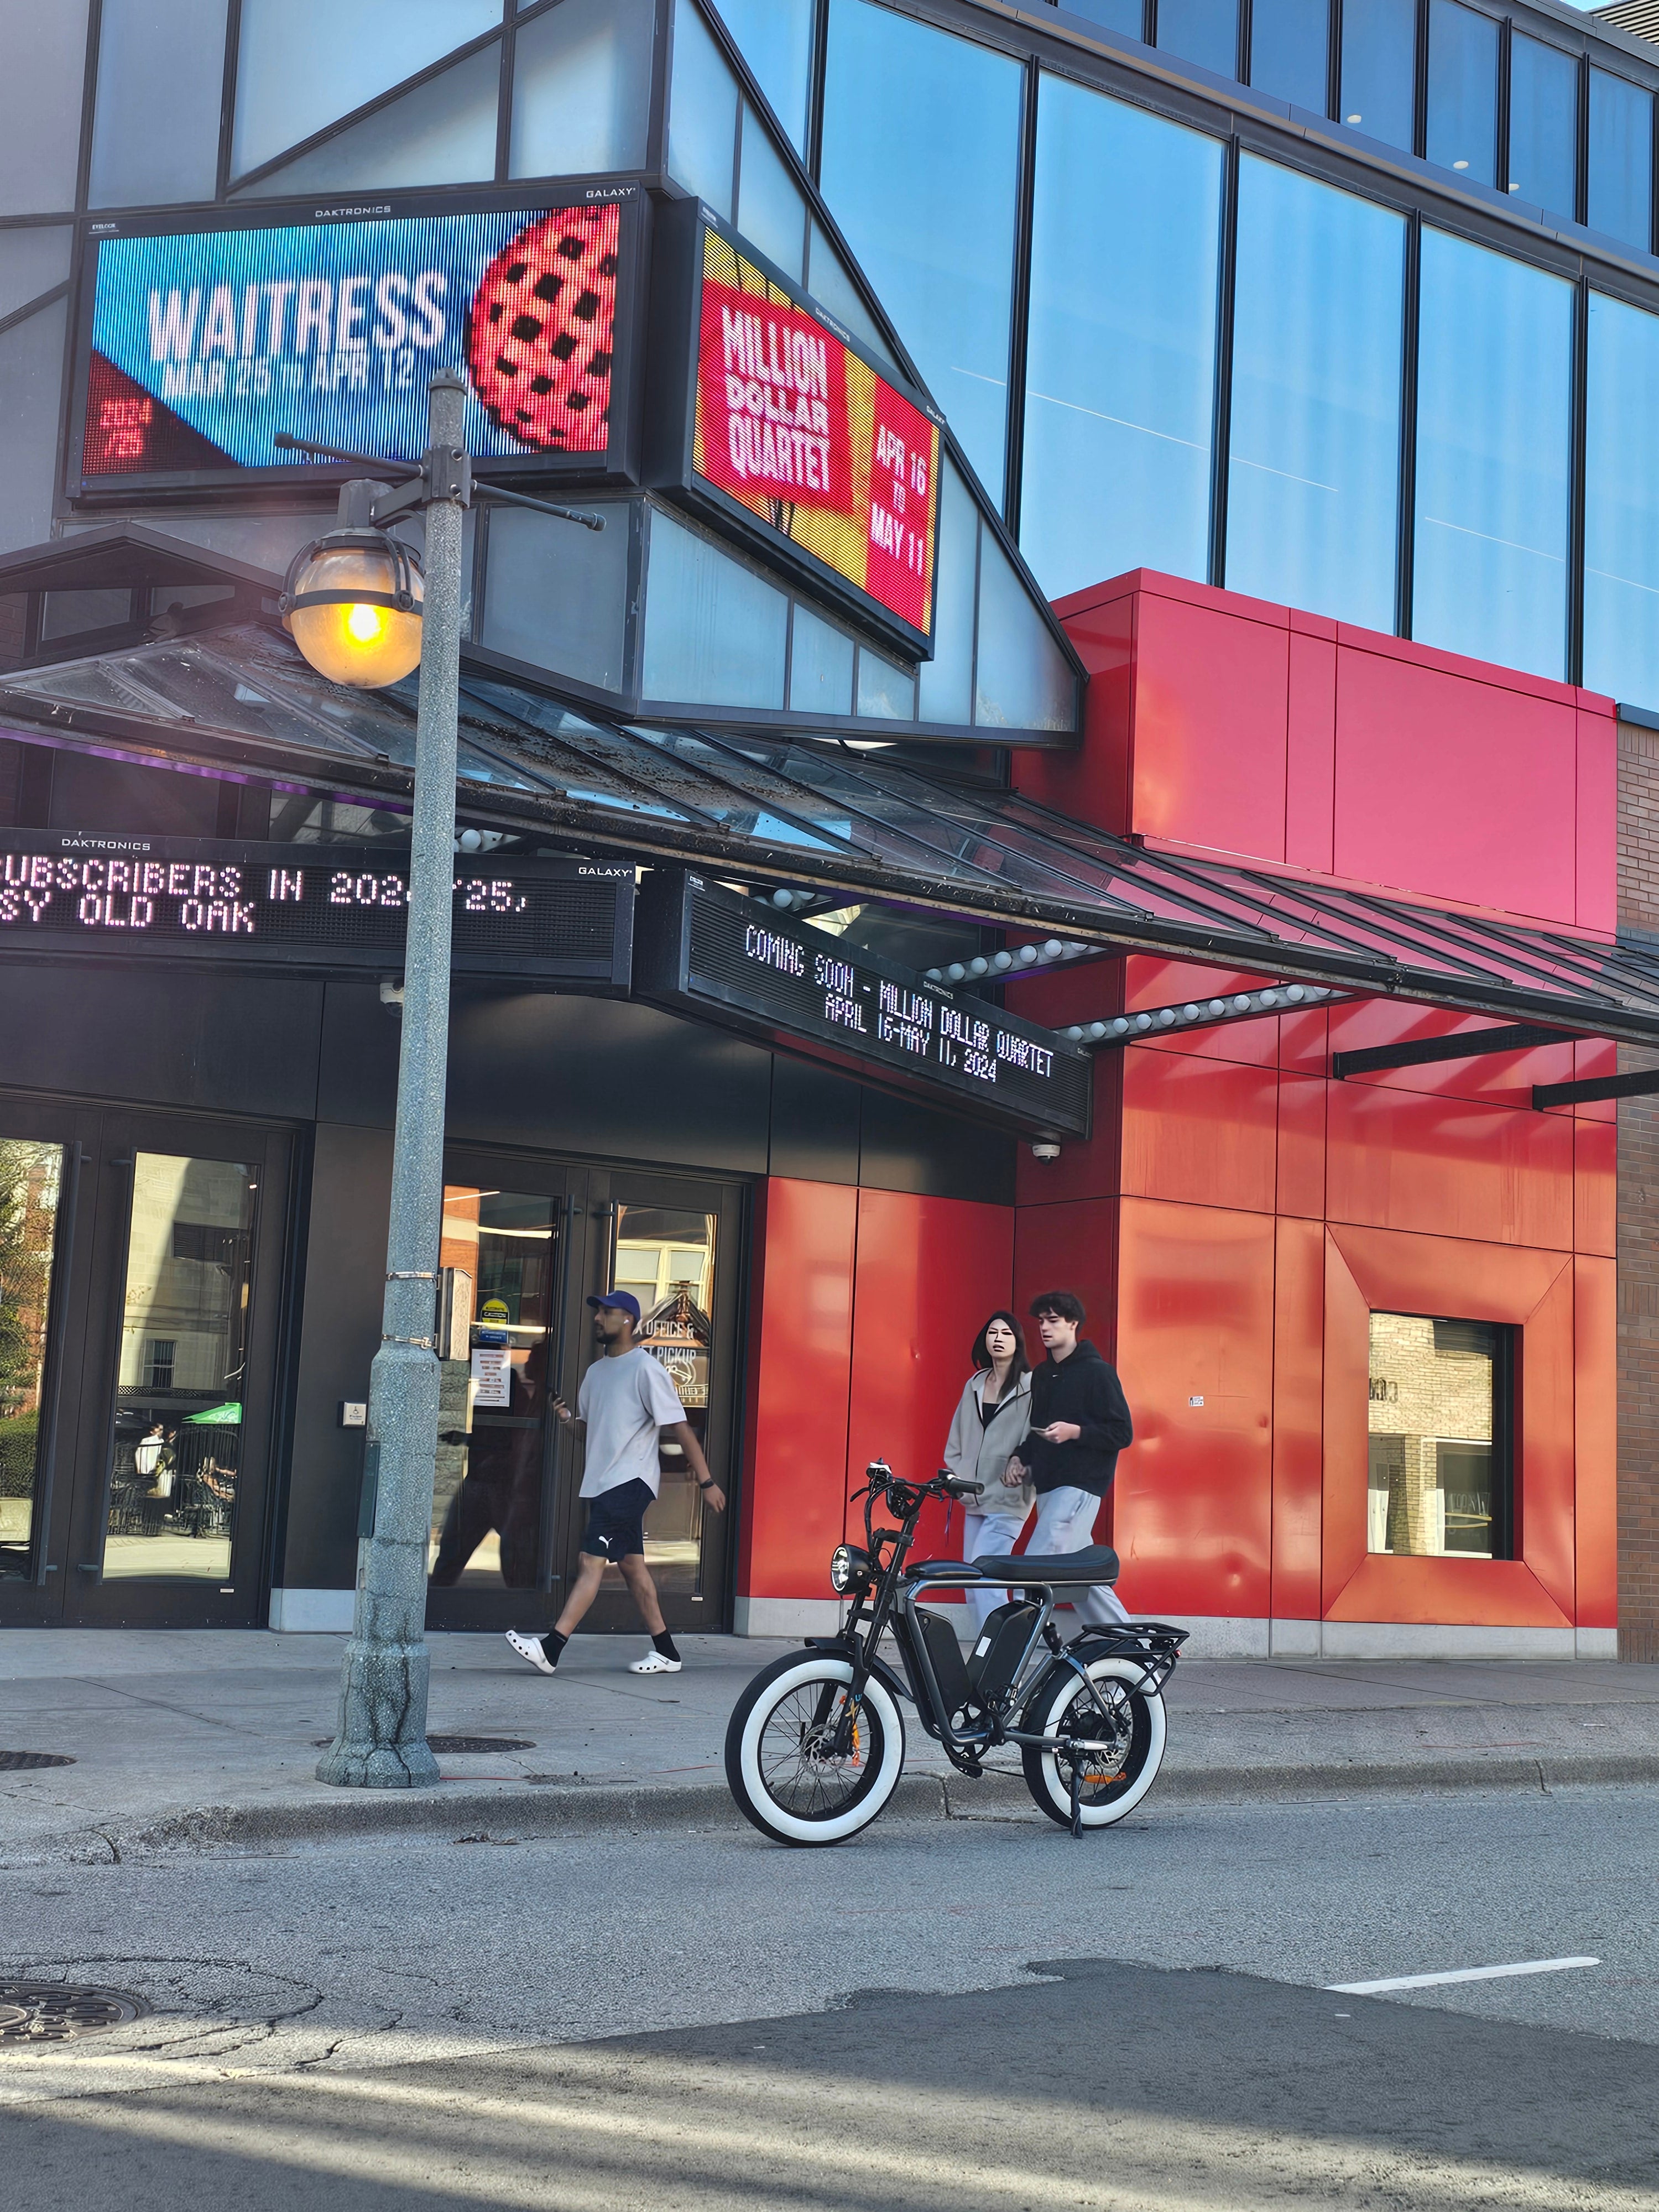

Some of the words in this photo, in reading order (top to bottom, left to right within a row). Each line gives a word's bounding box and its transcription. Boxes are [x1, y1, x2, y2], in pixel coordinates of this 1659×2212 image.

[315, 206, 391, 217] DAKTRONICS
[586, 187, 634, 198] GALAXY
[148, 271, 447, 362] WAITRESS
[722, 304, 828, 401] MILLION
[725, 373, 829, 437] DOLLAR
[728, 412, 830, 492] QUARTET
[877, 425, 905, 480] APR
[911, 452, 927, 496] 16
[870, 502, 904, 560] MAY
[909, 532, 924, 576] 11
[61, 838, 150, 851] DAKTRONICS
[578, 867, 630, 877] GALAXY
[0, 855, 241, 898] UBSCRIBERS
[269, 869, 303, 901] IN
[330, 872, 411, 906] 202
[80, 894, 152, 927] OLD
[182, 899, 254, 933] OAK
[747, 924, 805, 977] COMING
[814, 954, 854, 998] SOON
[879, 980, 933, 1030] MILLION
[940, 1005, 990, 1052] DOLLAR
[997, 1030, 1054, 1078] QUARTET
[826, 993, 867, 1033] APRIL
[878, 1013, 930, 1056] 16-MAY
[939, 1037, 957, 1066] 11,
[963, 1048, 996, 1083] 2024
[646, 1320, 683, 1338] OFFICE
[687, 1323, 695, 1339] &
[657, 1347, 697, 1364] PICKUP
